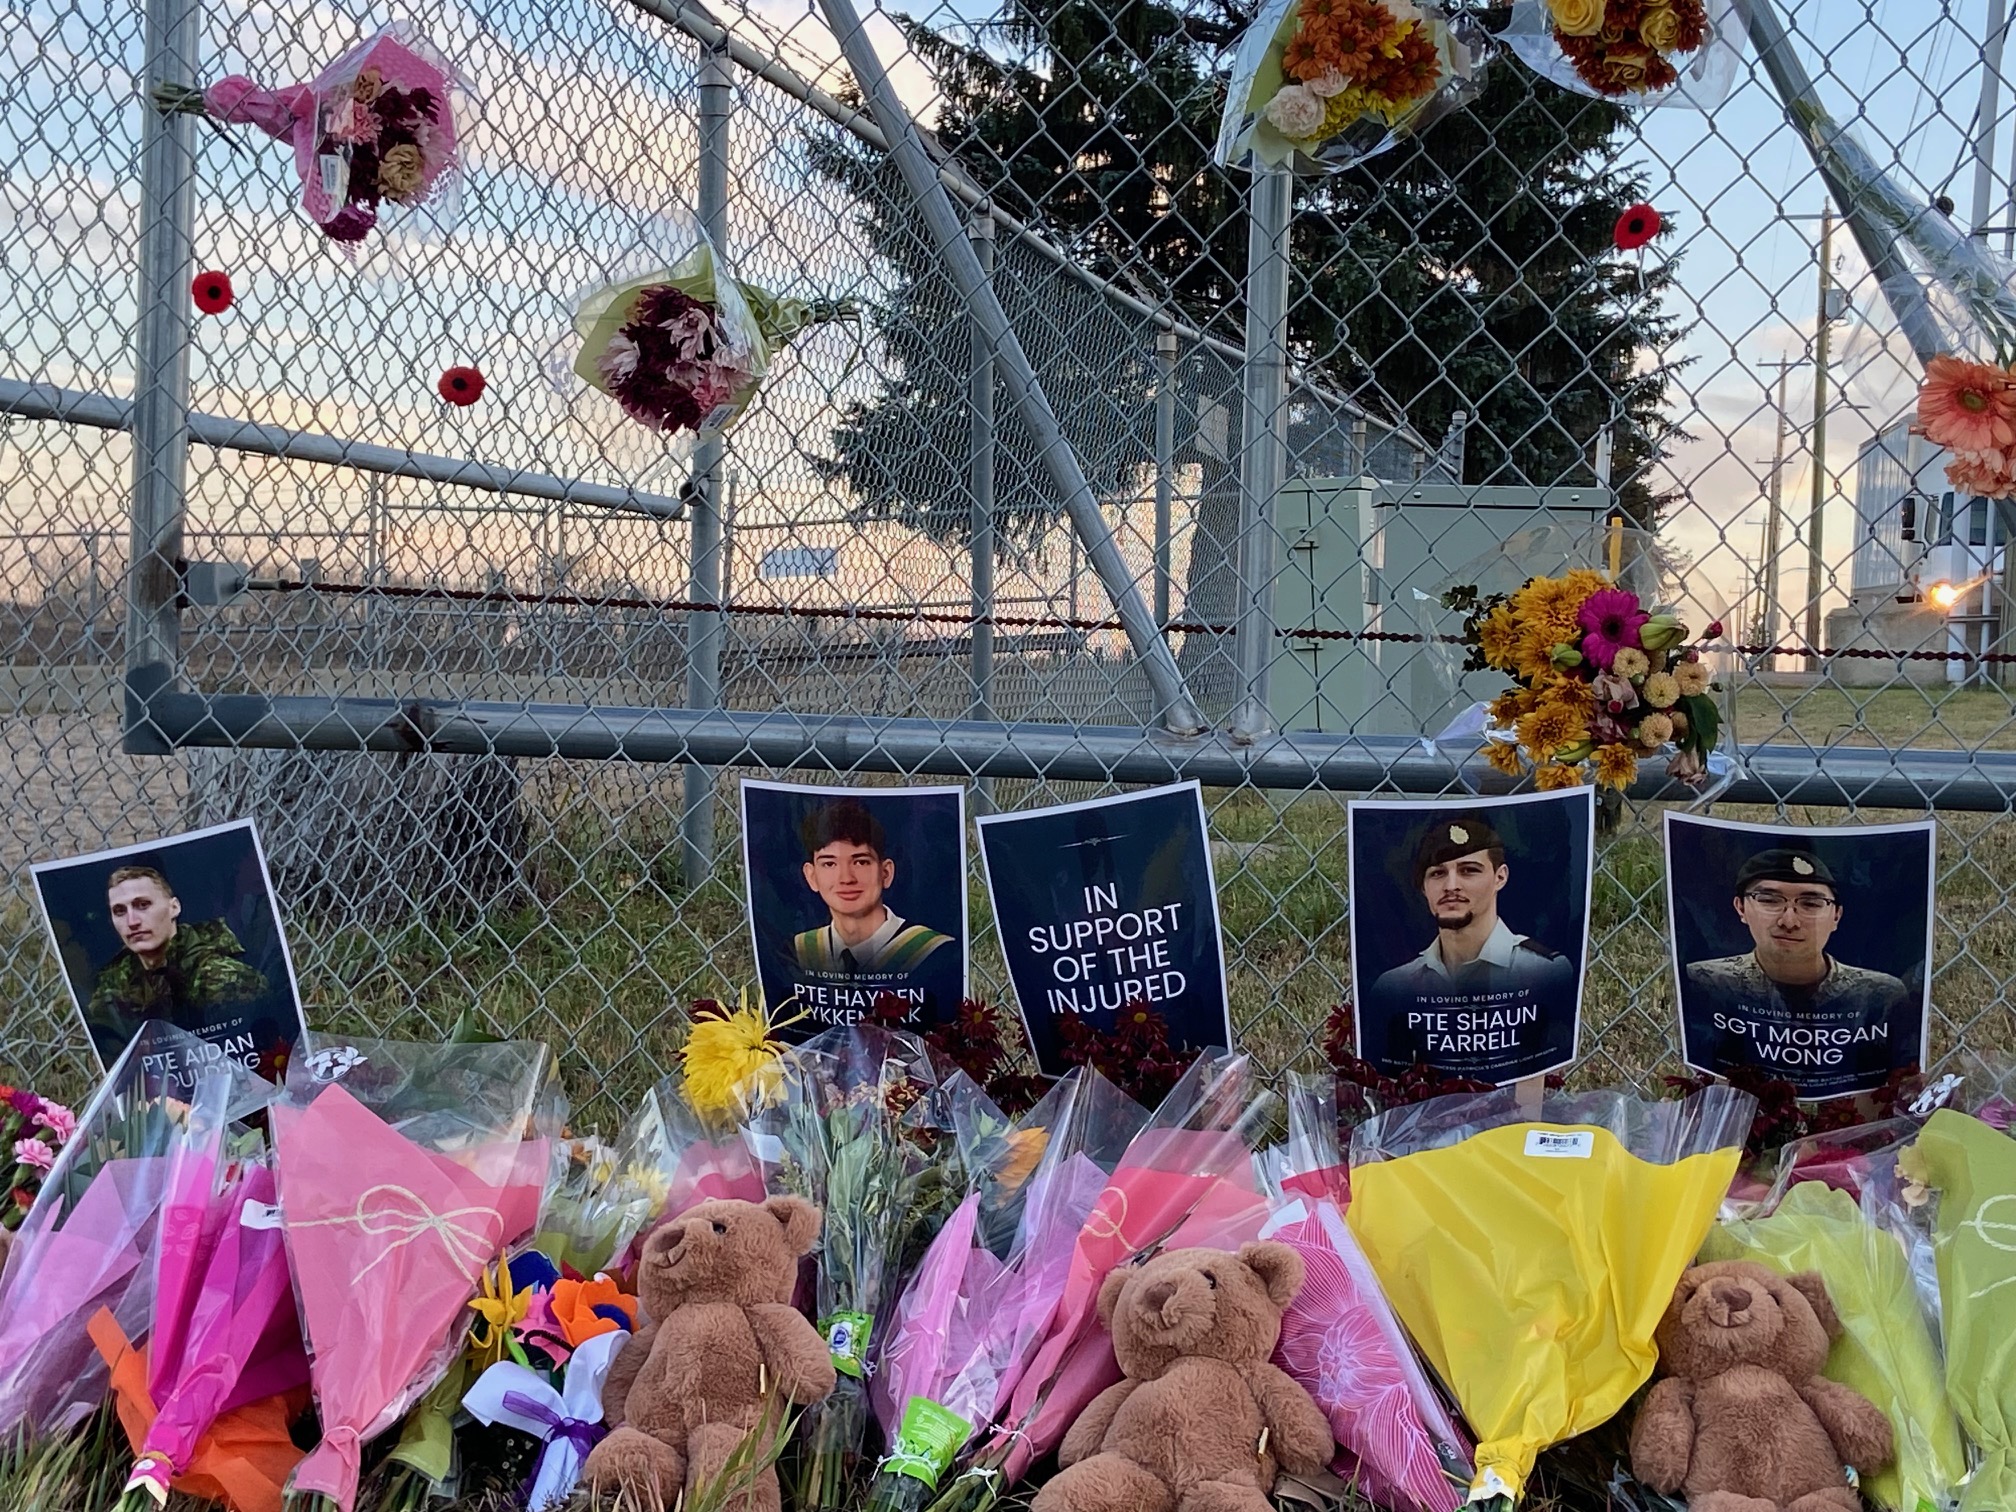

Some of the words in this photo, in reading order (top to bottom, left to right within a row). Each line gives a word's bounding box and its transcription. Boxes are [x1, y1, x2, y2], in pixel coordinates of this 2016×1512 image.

[1084, 882, 1118, 914] IN
[1028, 902, 1182, 953] SUPPORT
[805, 969, 815, 977] IN
[818, 971, 851, 980] LOVING
[854, 973, 894, 981] MEMORY
[897, 972, 909, 980] OF
[1053, 952, 1097, 983] OF
[1106, 939, 1171, 975] THE
[793, 983, 828, 1005] PTE
[835, 987, 924, 1007] HAYEN
[1047, 971, 1186, 1014] INJURED
[1431, 996, 1469, 1004] LOVING
[1472, 992, 1514, 1002] MEMORY
[1518, 989, 1530, 998] OF
[1408, 1012, 1449, 1031] PTE
[1456, 1004, 1537, 1031] SHAUN
[1738, 1003, 1749, 1012] IN
[1752, 1007, 1792, 1019] LOVING
[1796, 1012, 1843, 1020] MEMORY
[1847, 1011, 1861, 1019] OF
[153, 1033, 187, 1046] LOVING
[189, 1021, 229, 1036] MEMORY
[231, 1017, 243, 1027] OF
[1426, 1029, 1521, 1053] FARRELL
[1713, 1012, 1761, 1038] SGT
[1769, 1022, 1888, 1047] MORGAN
[142, 1051, 179, 1072] PTE
[185, 1032, 255, 1067] AIDAN
[1756, 1041, 1844, 1066] WONG
